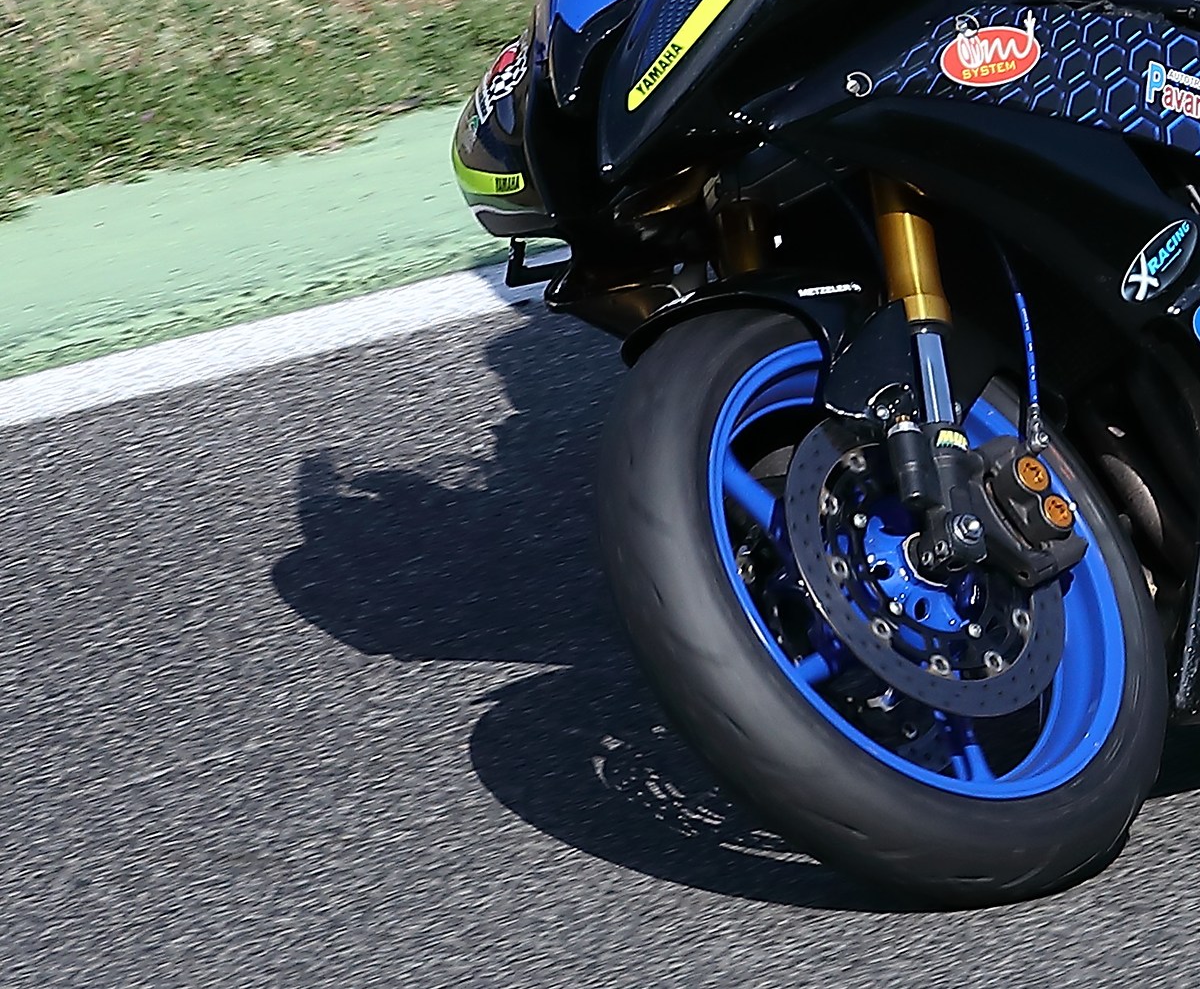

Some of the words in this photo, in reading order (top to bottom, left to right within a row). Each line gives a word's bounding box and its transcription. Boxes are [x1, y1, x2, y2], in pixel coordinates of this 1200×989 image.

[636, 43, 683, 95] YAMAHA
[961, 60, 1016, 80] SYSTEM
[1147, 220, 1190, 276] RACING
